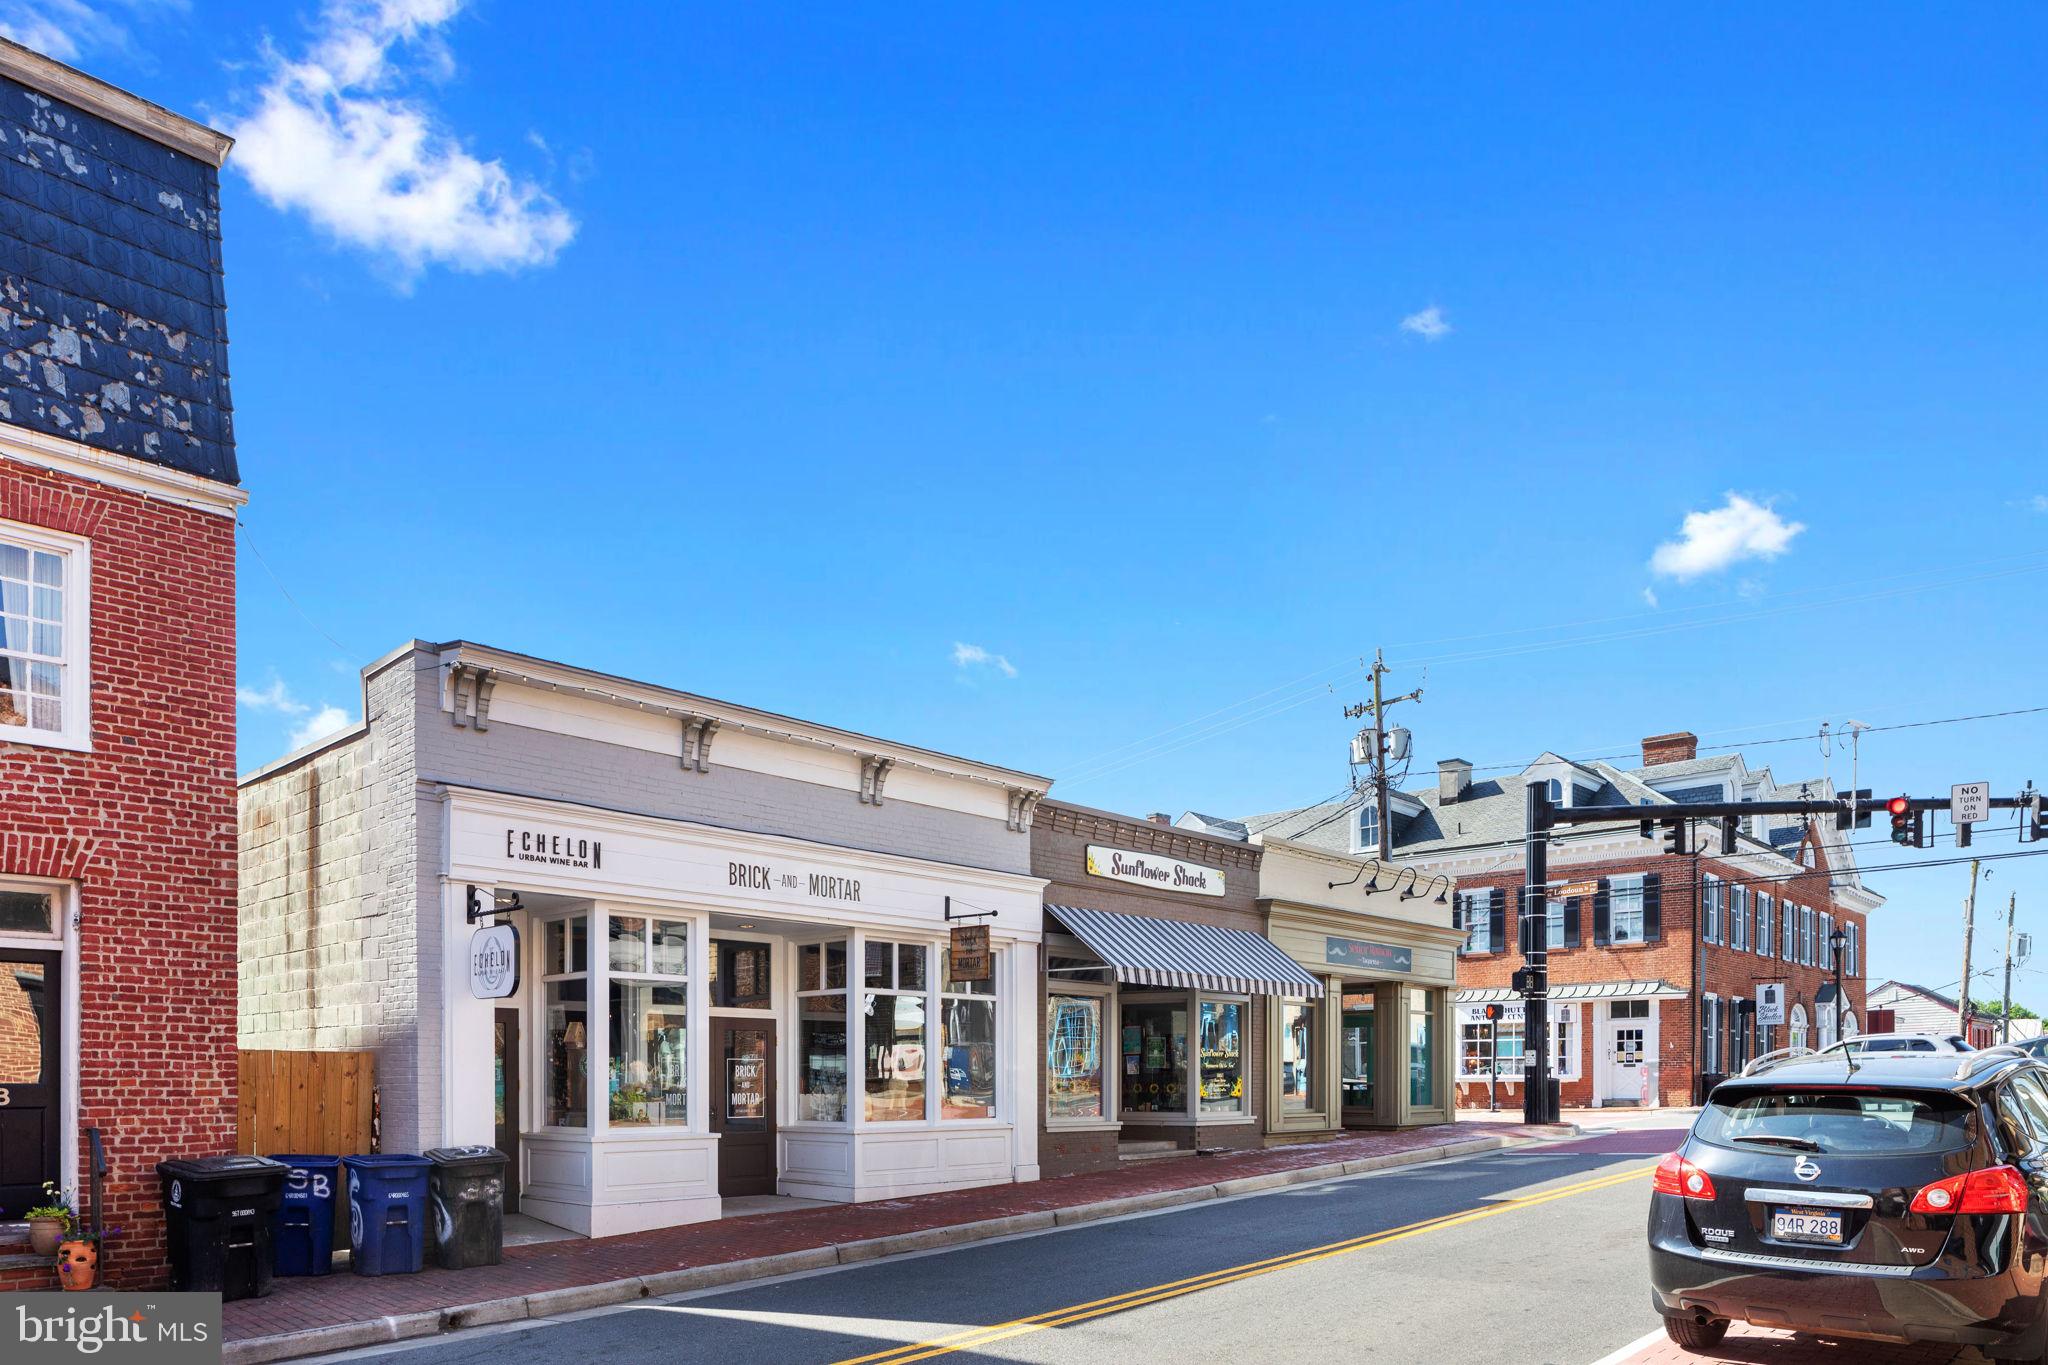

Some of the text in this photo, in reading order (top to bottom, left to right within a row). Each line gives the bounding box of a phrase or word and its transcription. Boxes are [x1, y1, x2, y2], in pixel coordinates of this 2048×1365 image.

[1961, 786, 1979, 795] NO
[1963, 804, 1976, 812] ON
[1961, 812, 1978, 820] RED
[507, 829, 601, 869] ECHELON
[518, 853, 588, 869] URBAN WINE BAR
[1111, 852, 1207, 889] Sunflower Shack
[728, 861, 861, 902] BRICK AND MORTAR
[1554, 886, 1584, 896] Loudoun
[474, 950, 511, 976] ECHELON
[735, 1064, 758, 1078] BRICK
[731, 1092, 760, 1105] MORTAR
[1701, 1227, 1735, 1237] ROGUE
[1777, 1217, 1805, 1233] 94R
[1810, 1219, 1838, 1235] 288
[1900, 1246, 1925, 1254] AWD
